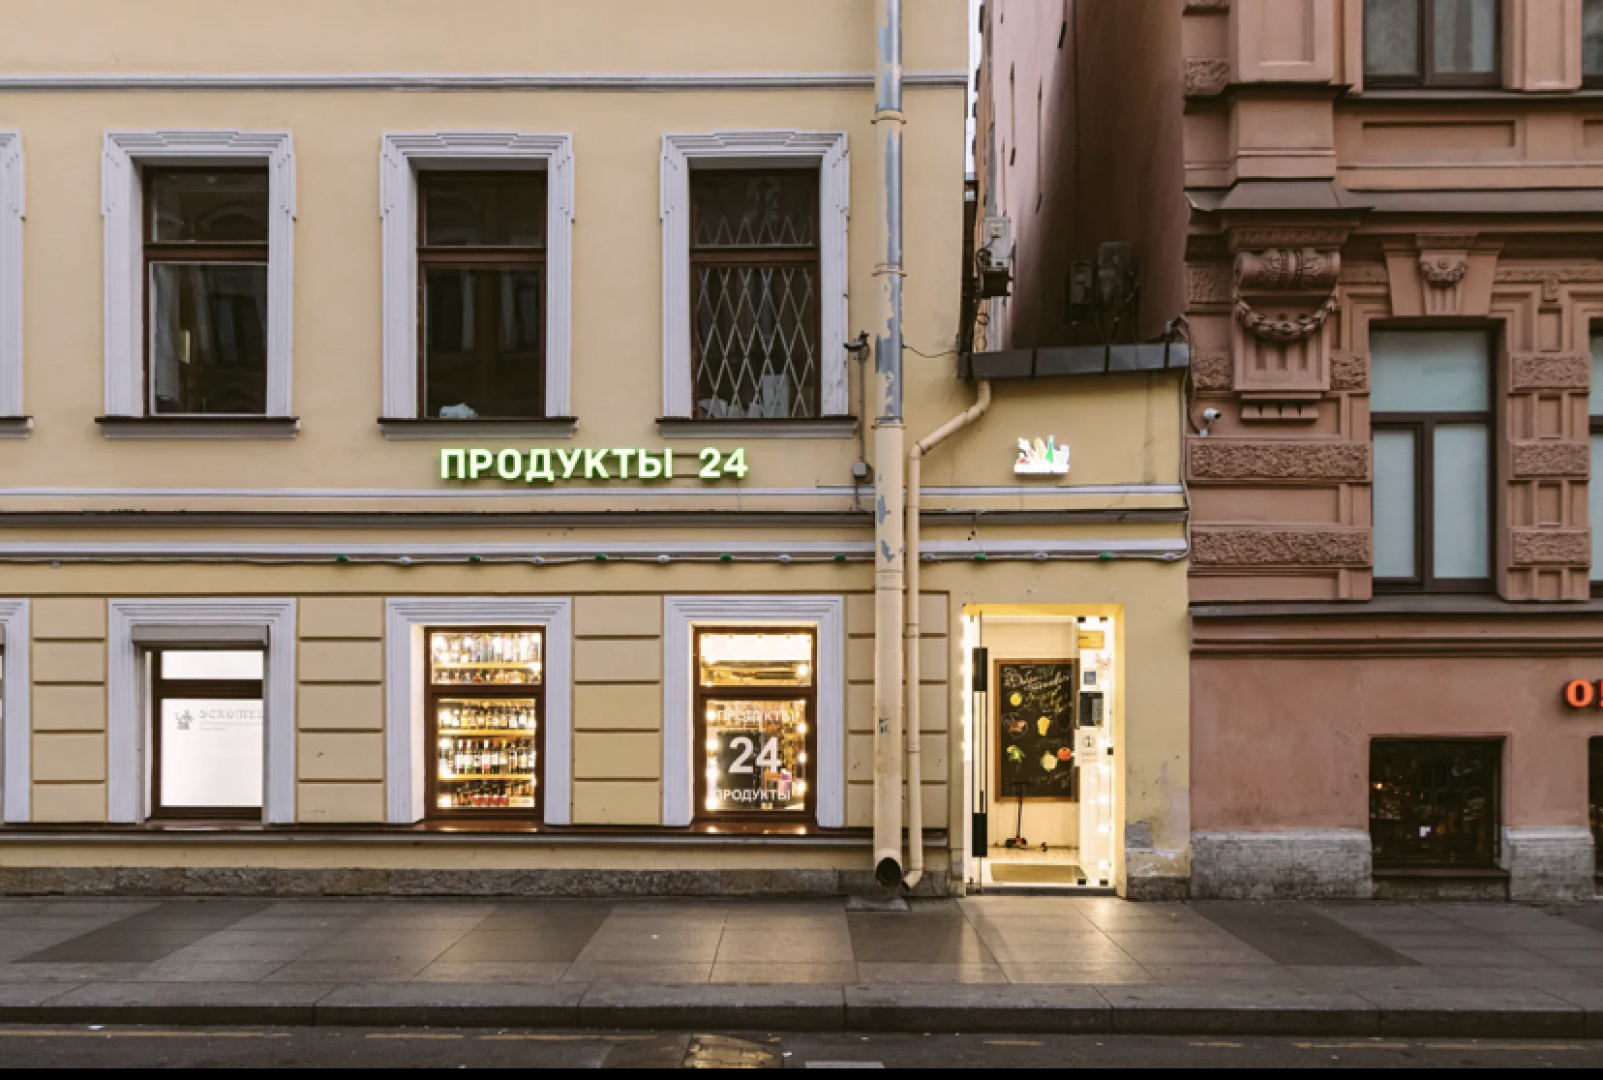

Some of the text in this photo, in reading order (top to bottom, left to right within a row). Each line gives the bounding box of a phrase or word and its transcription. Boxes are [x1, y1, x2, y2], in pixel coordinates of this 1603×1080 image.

[440, 446, 748, 482] ПРОДУКТЫ 24
[1566, 678, 1603, 708] O
[729, 736, 781, 773] 24
[714, 788, 791, 802] ПРОДУКТЫ
